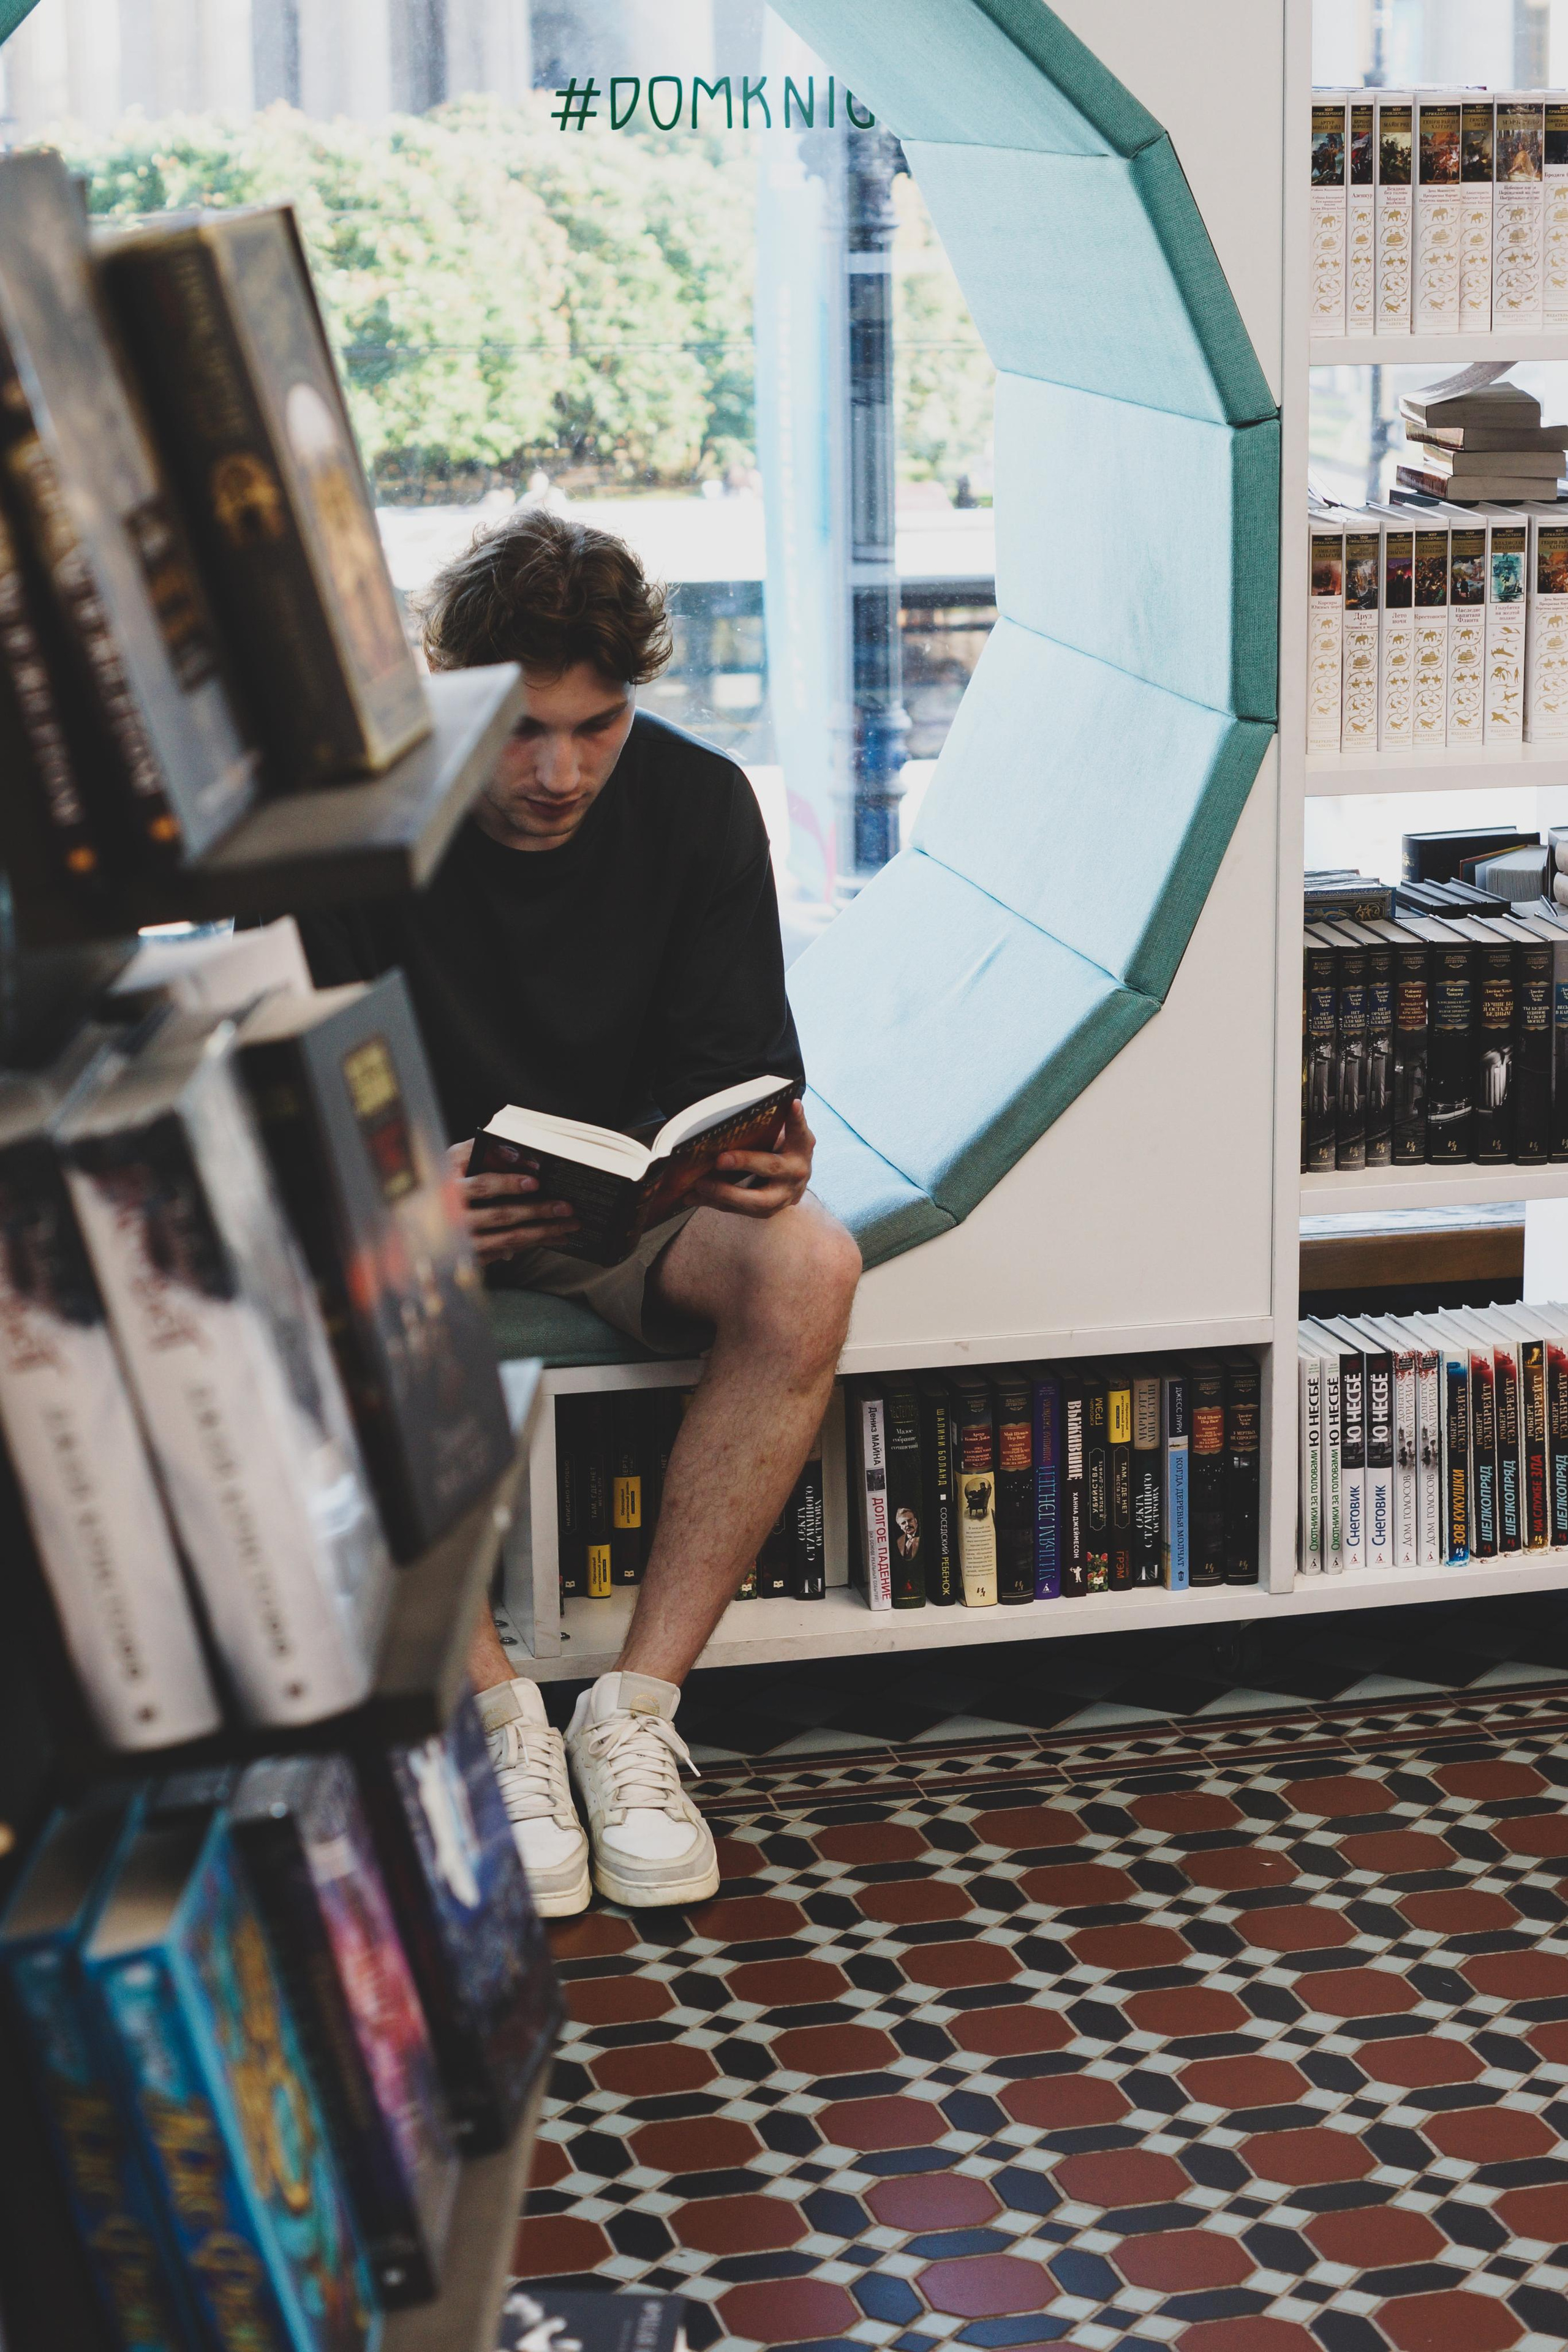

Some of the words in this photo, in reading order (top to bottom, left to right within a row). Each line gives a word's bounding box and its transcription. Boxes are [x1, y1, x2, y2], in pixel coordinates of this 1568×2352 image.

[1308, 1378, 1319, 1426] НЕСБЁ
[1327, 1377, 1339, 1425] НЕСБЁ
[1344, 1373, 1362, 1422] НЕСБЁ
[1370, 1373, 1388, 1422] НЕСБЁ
[1456, 1386, 1466, 1453] ГЭЛБРЕЙТ
[1481, 1383, 1493, 1450] ГЭЛБРЕЙТ
[1504, 1378, 1516, 1445] ГЭЛБРЕЙТ
[1532, 1375, 1544, 1442] ГЭЛБРЕЙТ
[1558, 1373, 1568, 1439] ГЭЛБРЕЙТ
[868, 1407, 877, 1433] Дениз
[937, 1409, 945, 1447] ШАЛИНИ
[1067, 1400, 1083, 1481] ВЫЖИВШИЕ
[1309, 1430, 1319, 1447] Ю
[1329, 1429, 1339, 1446] Ю
[1346, 1425, 1362, 1443] Ю
[1372, 1425, 1388, 1443] Ю
[872, 1434, 882, 1466] МАЙНА
[938, 1449, 948, 1486] БОЛАНД
[1530, 1455, 1542, 1478] ЗЛА
[1136, 1494, 1144, 1528] СЕКТА
[1311, 1496, 1317, 1507] за
[1332, 1494, 1339, 1506] за
[1403, 1475, 1411, 1519] ГОЛОСОВ
[1453, 1469, 1465, 1522] КУКУШКИ
[1480, 1466, 1493, 1542] ШЕЛКОПРЯД
[1504, 1460, 1516, 1536] ШЕЛКОПРЯД
[1532, 1481, 1543, 1517] СЛУЖБЕ
[1556, 1454, 1568, 1530] ШЕЛКОПРЯД
[872, 1498, 886, 1544] ДОЛГОЕ
[940, 1507, 949, 1556] СОСЕДСКИЙ
[1309, 1507, 1318, 1551] Охотники
[1331, 1506, 1340, 1551] Охотники
[1403, 1523, 1413, 1547] ДОМ
[1426, 1522, 1436, 1545] ДОМ
[1453, 1524, 1466, 1545] ЗОВ
[1534, 1518, 1543, 1531] НА
[878, 1547, 891, 1600] ПАДЕНИЕ
[1039, 1526, 1055, 1580] УИЛЬЯМ
[1116, 1551, 1125, 1578] ГРЭМ
